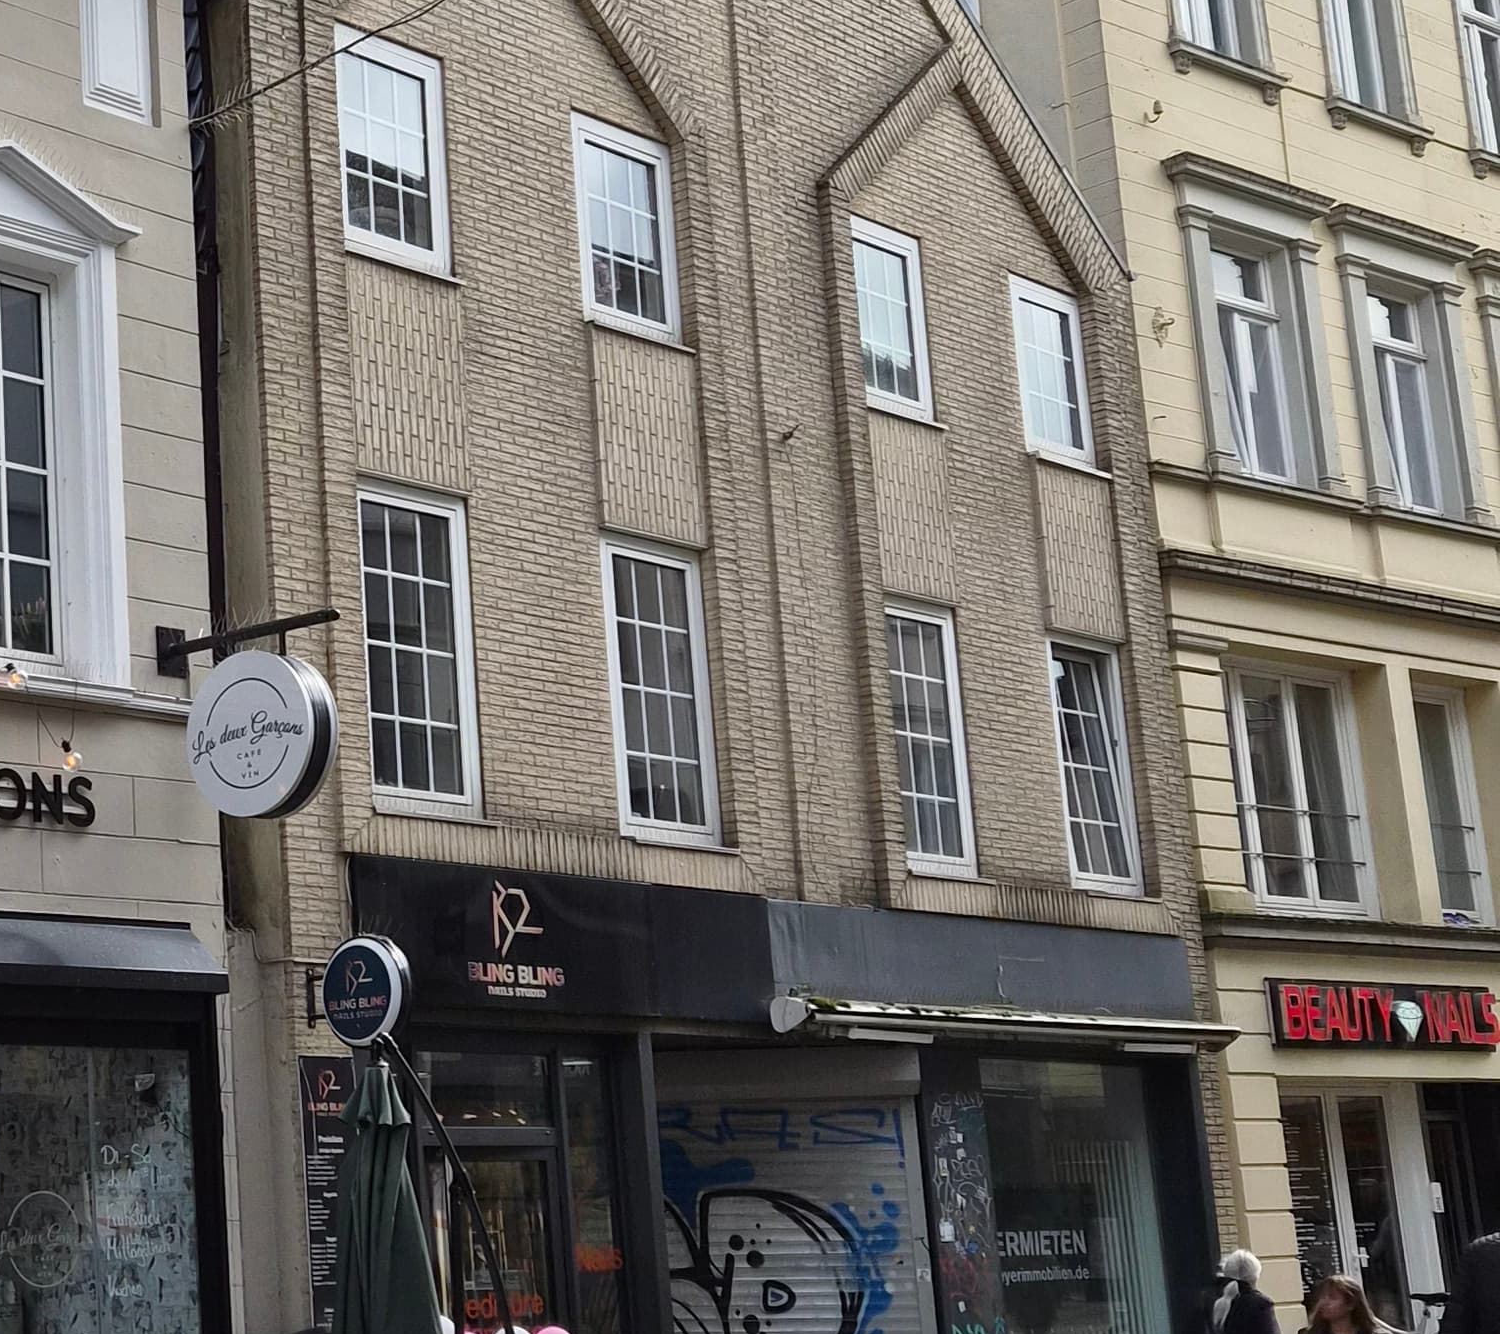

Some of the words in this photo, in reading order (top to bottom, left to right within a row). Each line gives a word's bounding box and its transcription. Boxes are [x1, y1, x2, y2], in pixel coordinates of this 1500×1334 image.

[192, 730, 216, 764] Les
[219, 723, 248, 745] deux
[250, 710, 305, 745] Garçons
[240, 770, 260, 780] VIN
[467, 961, 515, 984] BLING
[516, 965, 565, 987] BLING
[328, 998, 357, 1011] BLING
[359, 995, 387, 1008] BLING
[1278, 984, 1394, 1042] BEAUTY
[1416, 990, 1500, 1044] NAILS
[997, 1229, 1088, 1258] ERMIETEN
